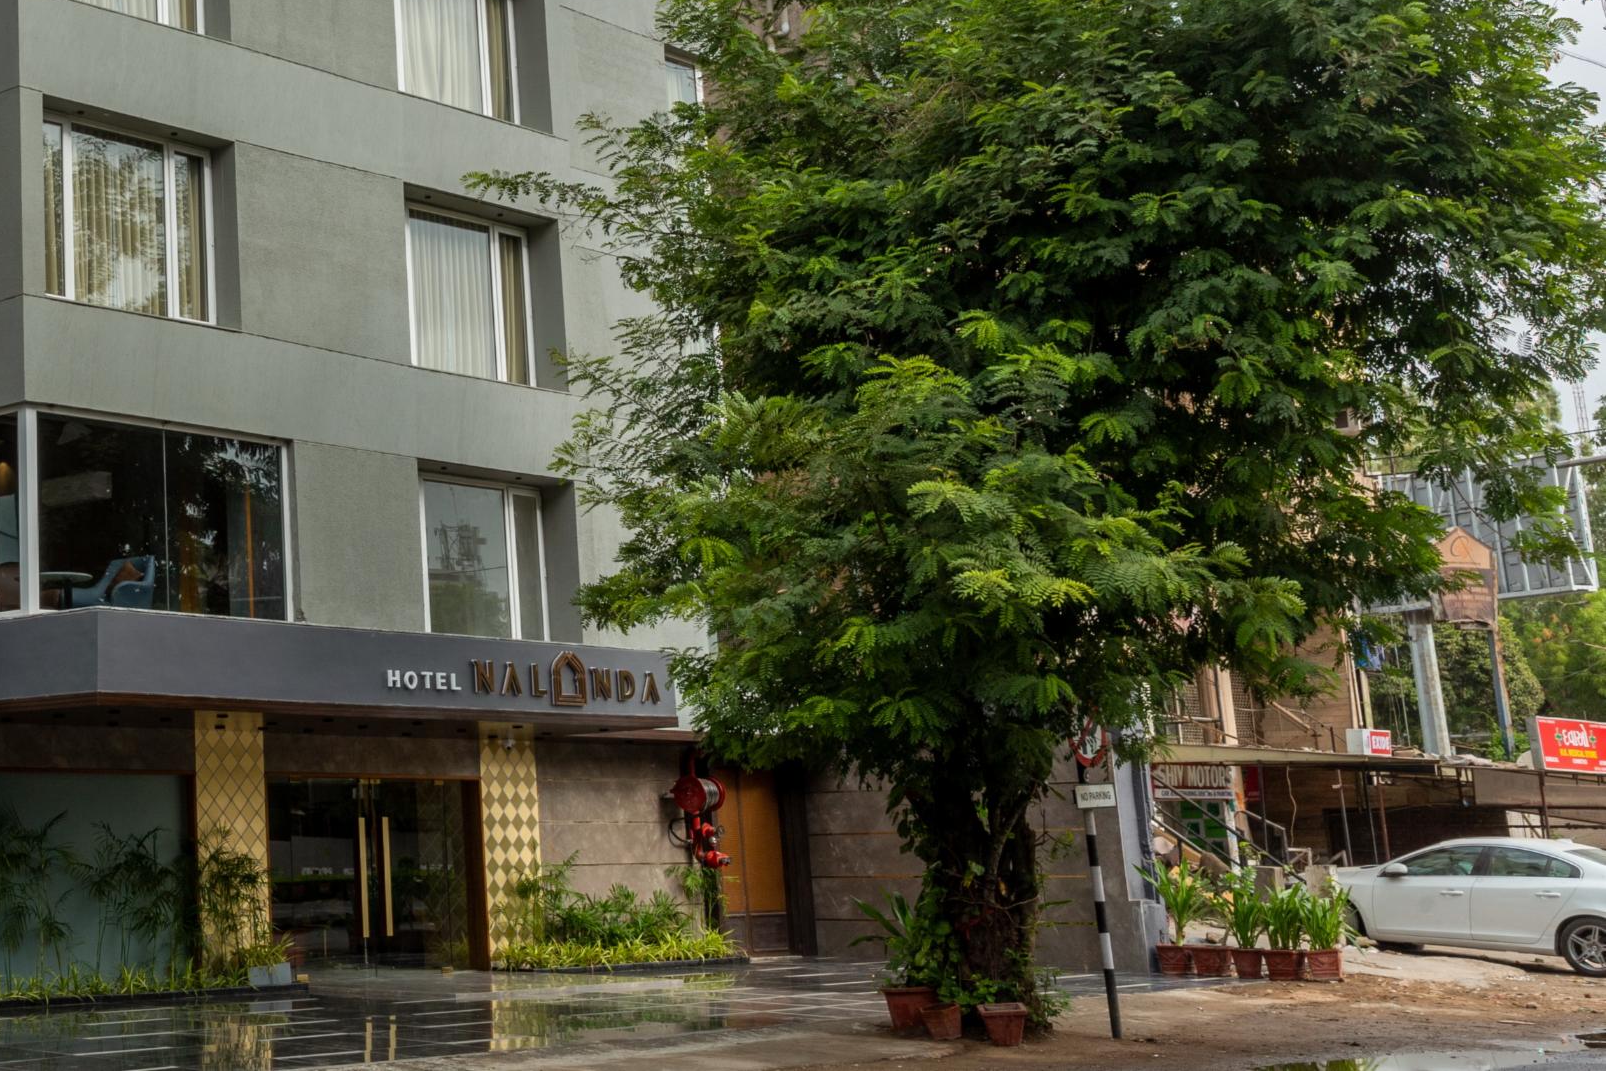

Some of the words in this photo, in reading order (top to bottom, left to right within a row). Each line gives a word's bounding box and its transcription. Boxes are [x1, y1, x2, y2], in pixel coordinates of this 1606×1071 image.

[387, 669, 462, 691] HOTEL
[1153, 765, 1184, 787] SHIV
[1187, 765, 1233, 788] MOTORS
[1080, 792, 1088, 801] NO
[1089, 790, 1112, 801] PARKING
